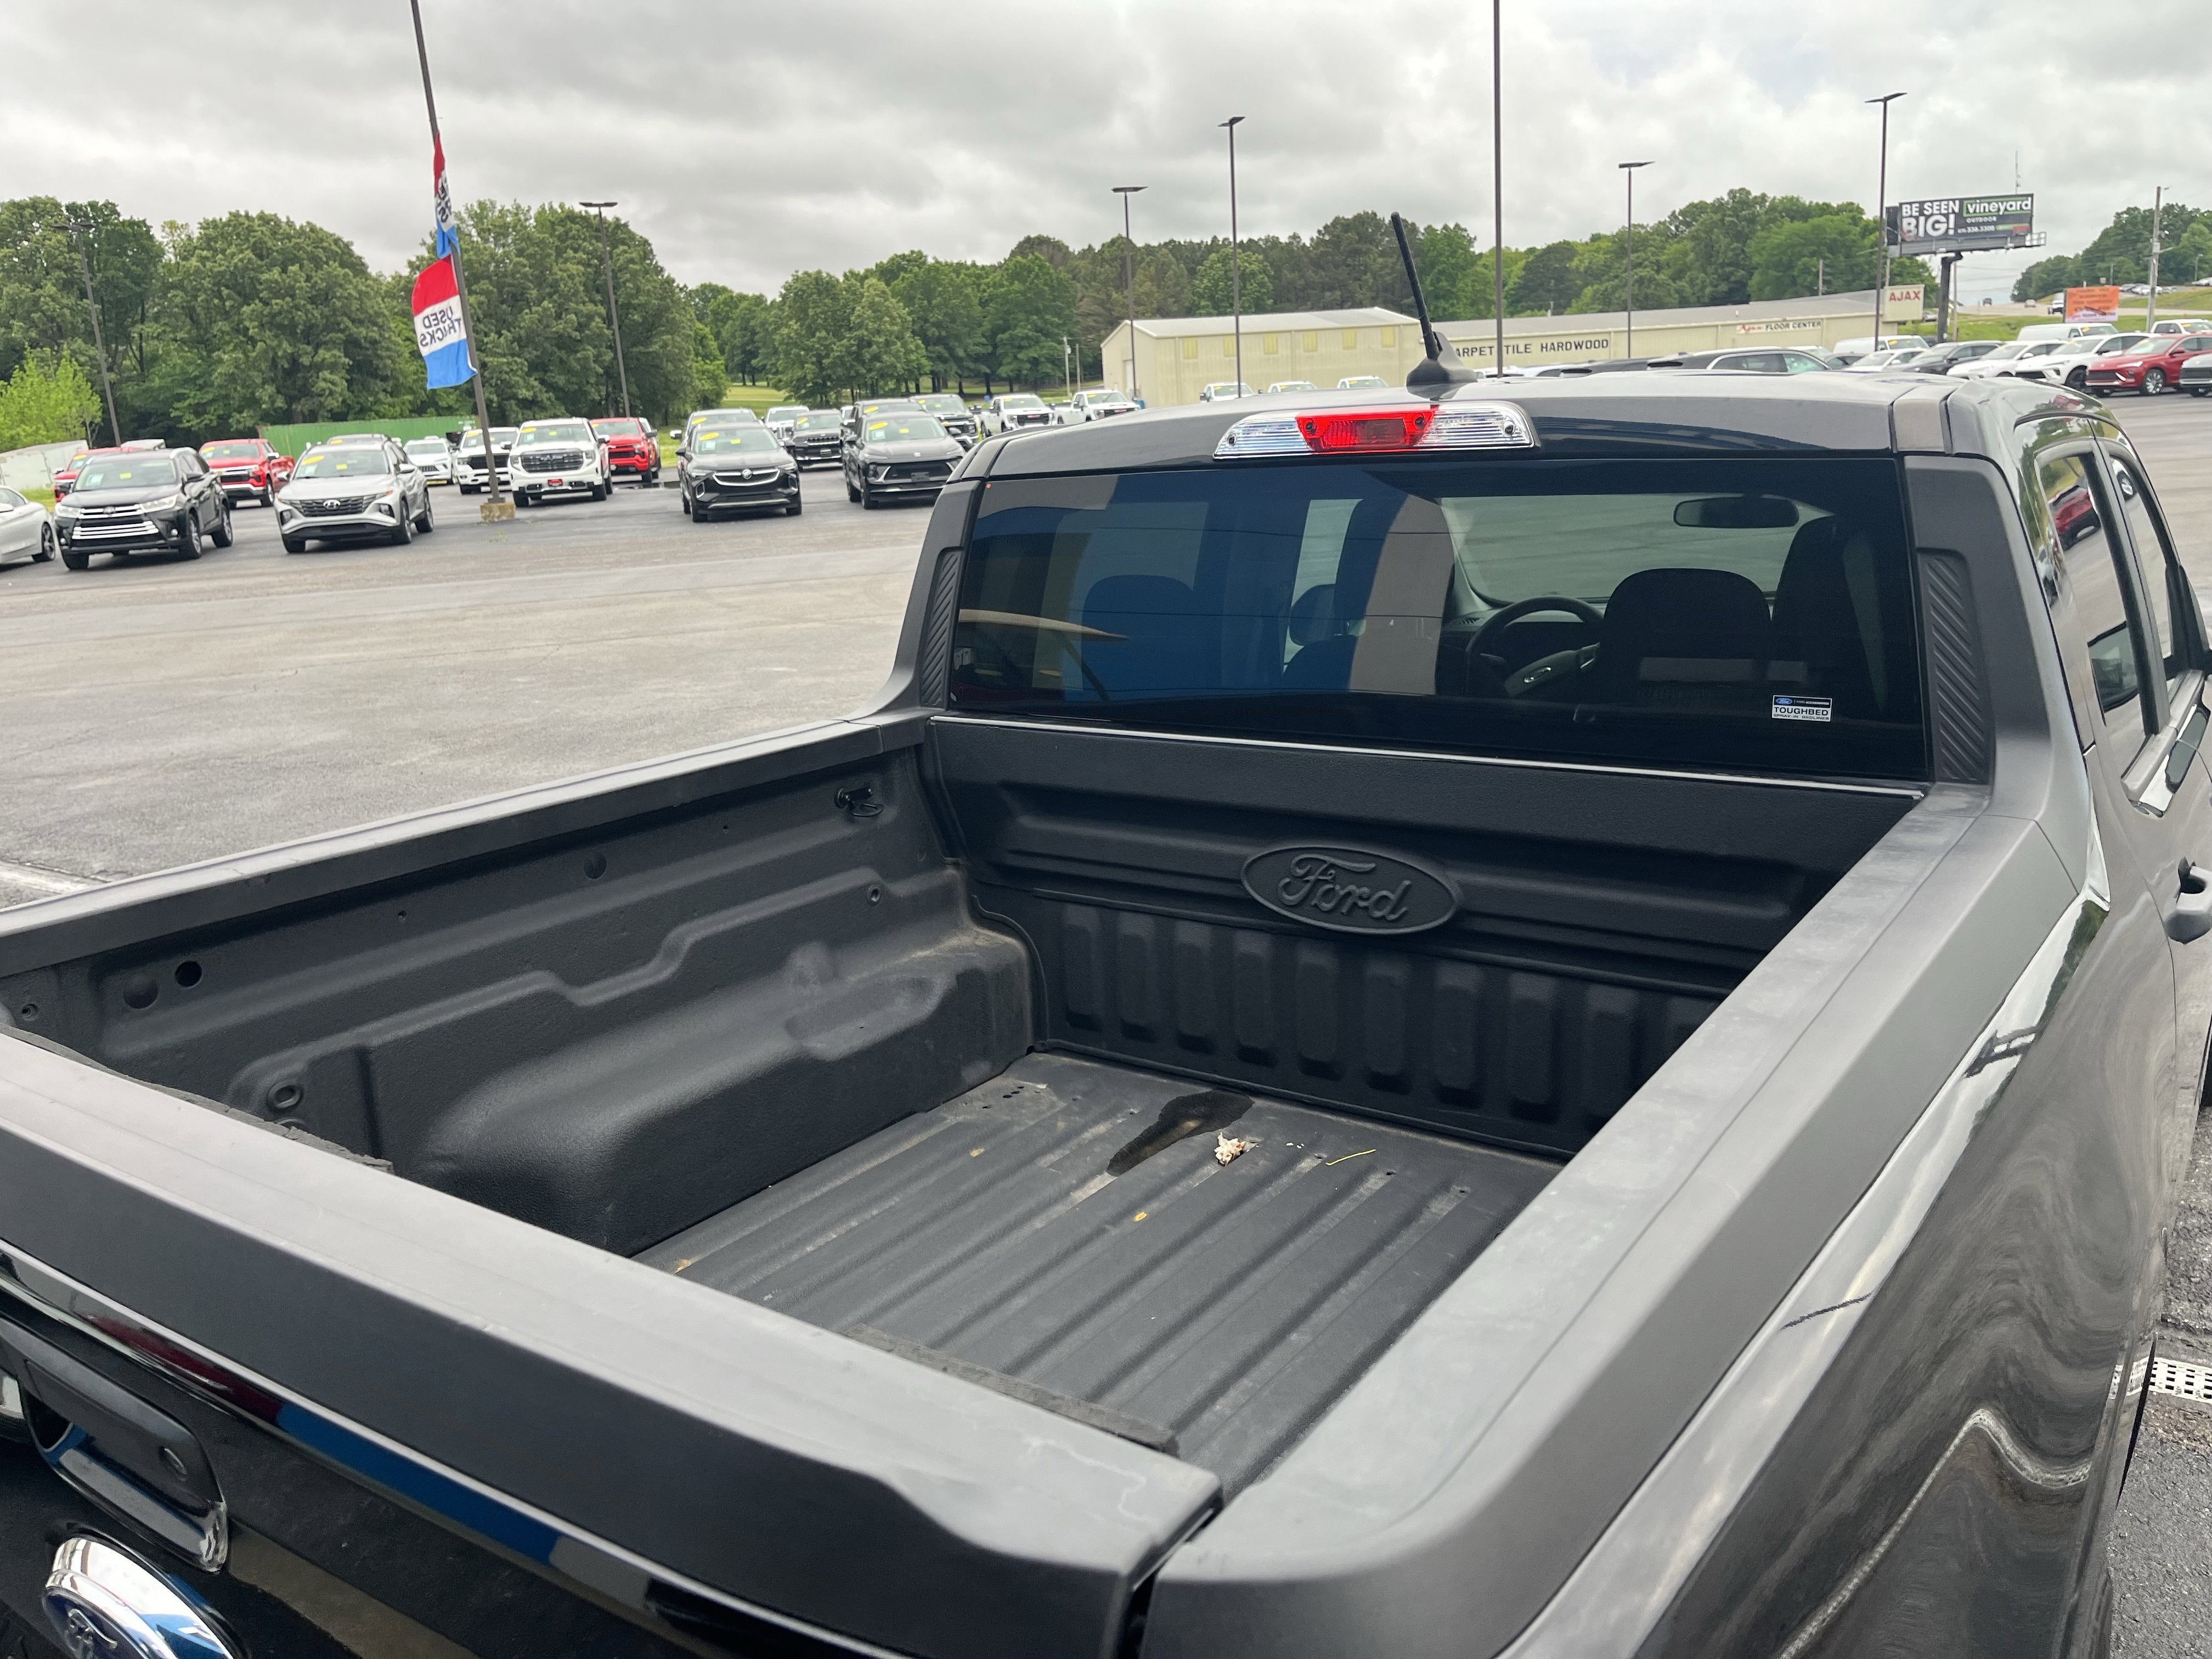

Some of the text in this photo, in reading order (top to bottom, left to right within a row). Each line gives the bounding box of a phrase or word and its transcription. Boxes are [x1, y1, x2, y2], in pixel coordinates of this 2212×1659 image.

[1902, 200, 1960, 217] BE SEEN
[1967, 198, 2031, 215] vineyard
[1902, 214, 1955, 237] BIG!
[1889, 290, 1921, 301] AJAX
[1792, 321, 1821, 329] CENTER
[1455, 339, 1609, 357] ARPET TILE HARDWOOD
[1774, 707, 1829, 715] TOUGHBED
[1278, 853, 1412, 922] Ford
